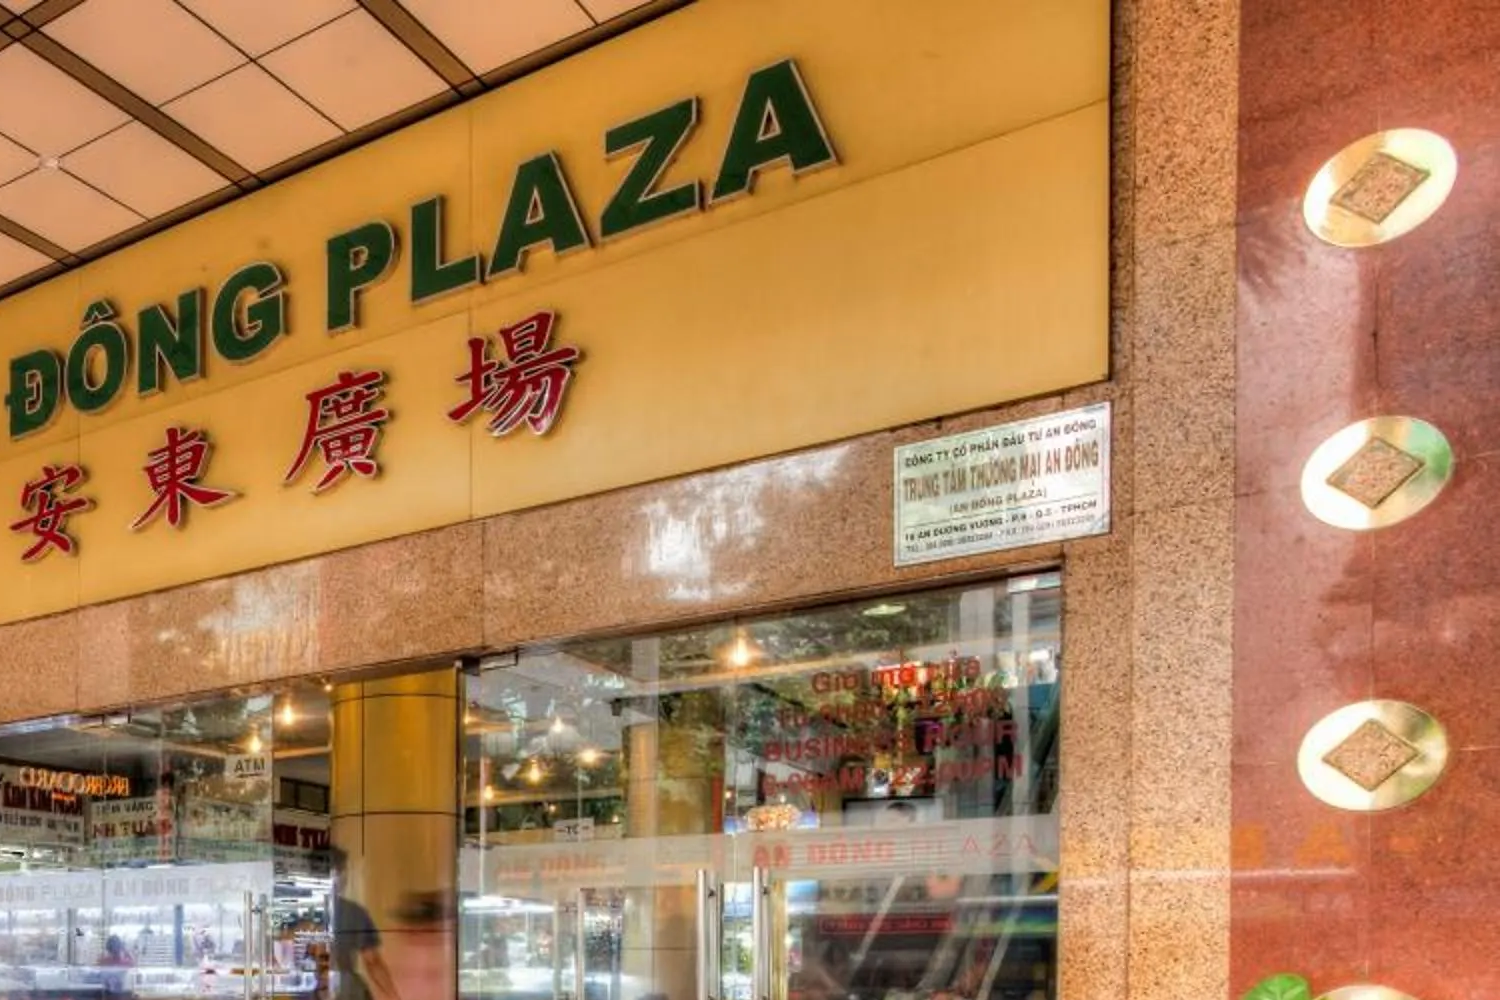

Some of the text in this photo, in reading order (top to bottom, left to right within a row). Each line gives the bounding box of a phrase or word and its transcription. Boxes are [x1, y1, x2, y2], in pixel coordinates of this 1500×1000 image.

[5, 262, 287, 441] ĐÔNG
[326, 57, 840, 334] PLAZA
[9, 310, 581, 562] 安東廣場
[903, 473, 940, 501] TRUNG
[1045, 448, 1061, 476] AN
[234, 758, 266, 774] ATM
